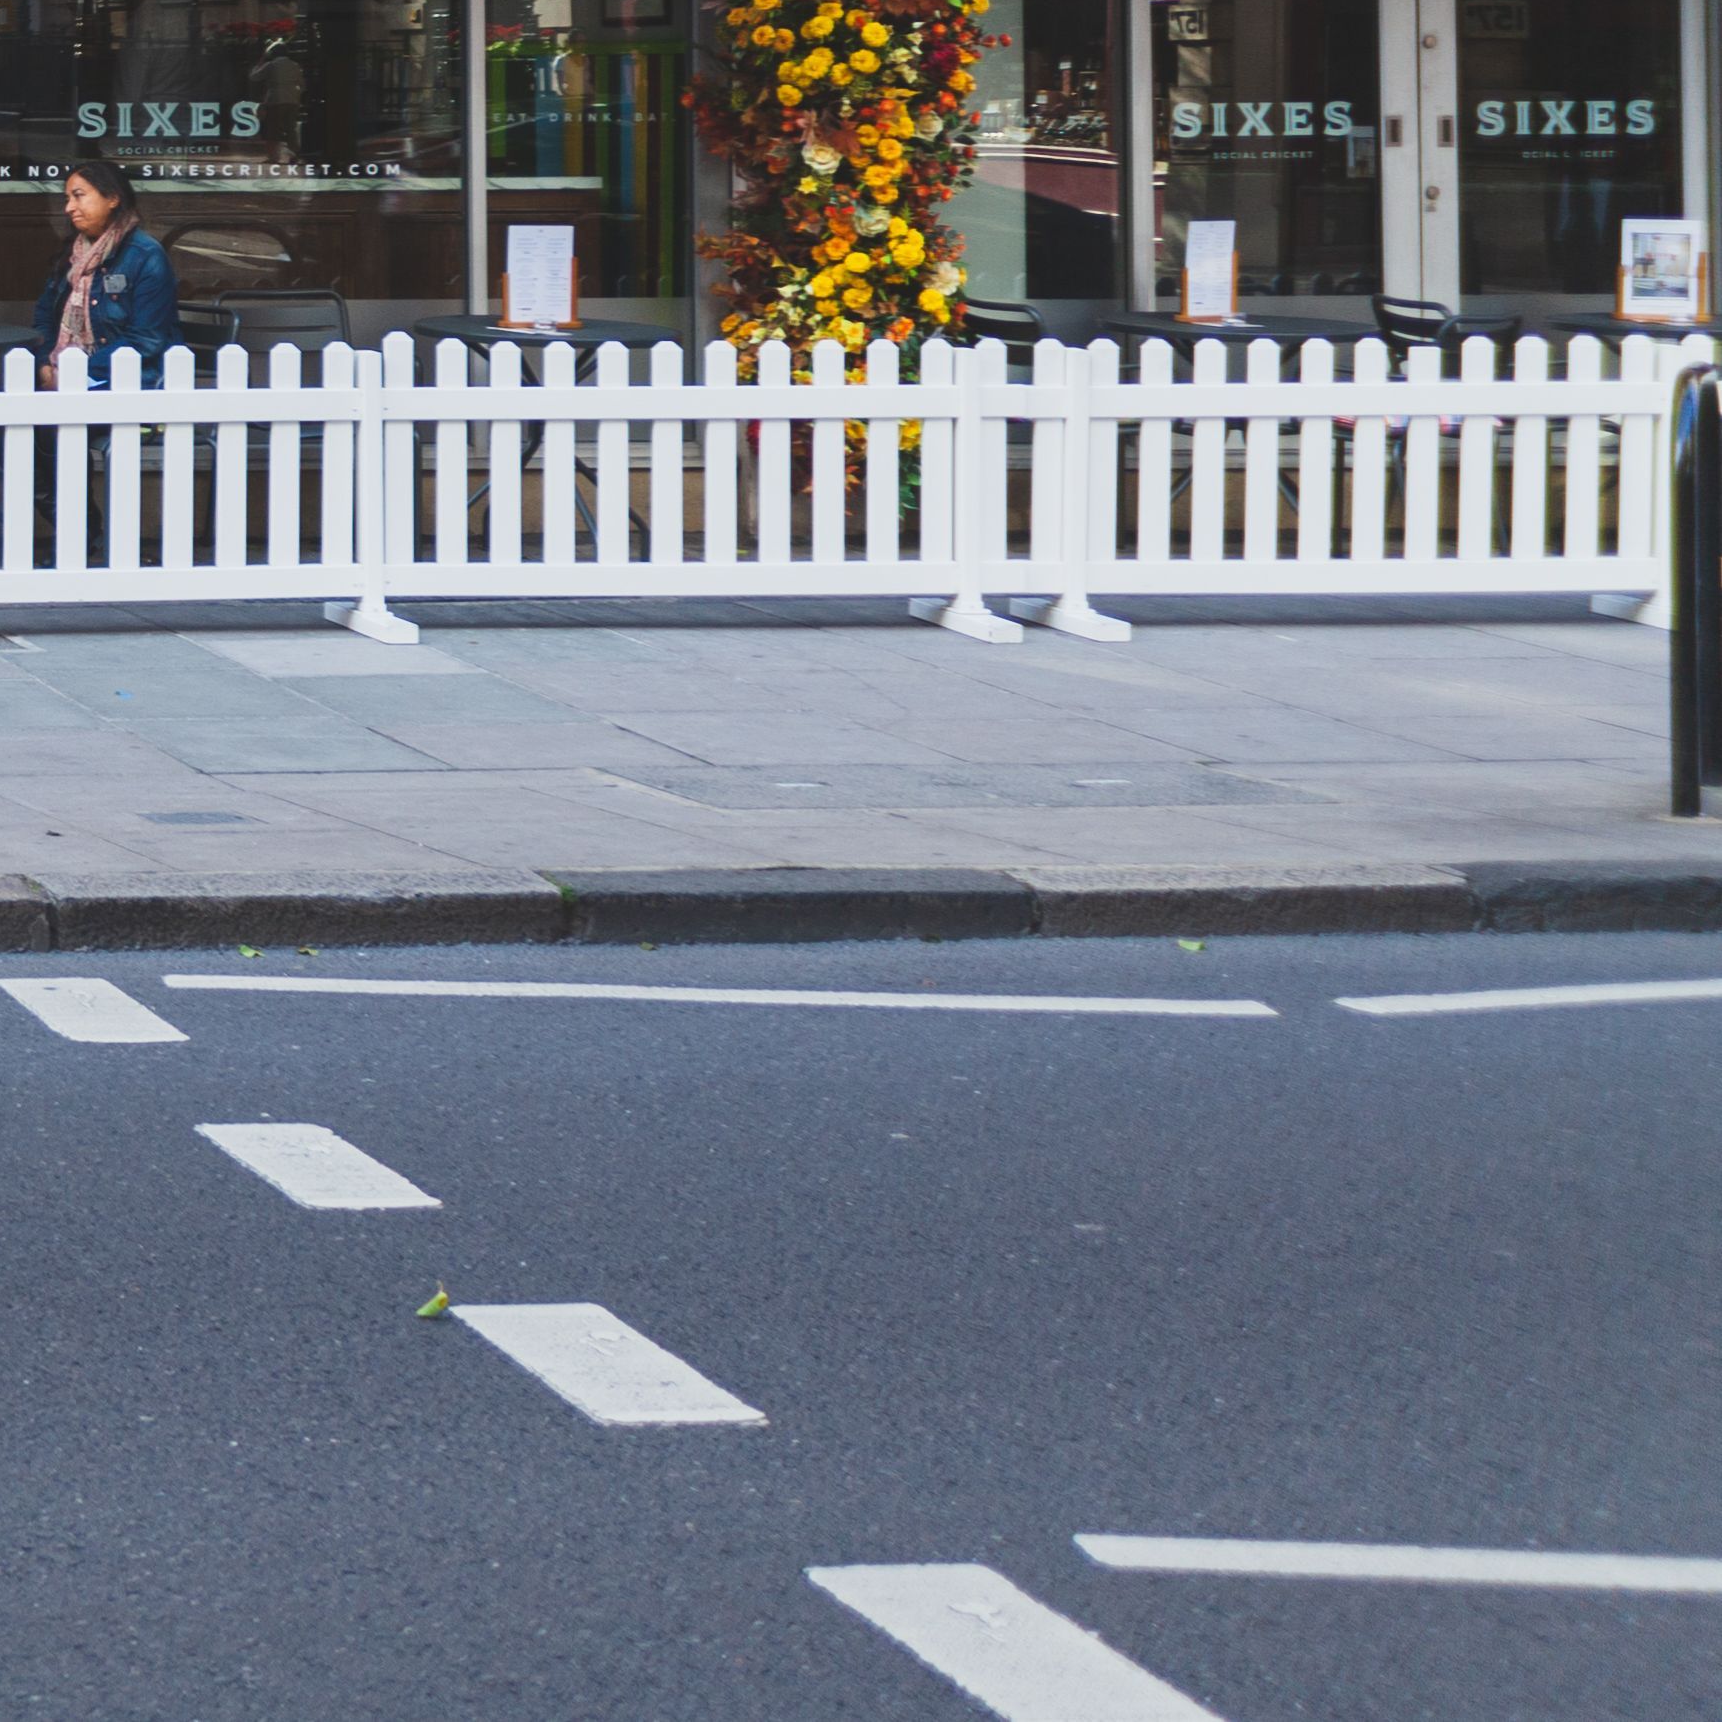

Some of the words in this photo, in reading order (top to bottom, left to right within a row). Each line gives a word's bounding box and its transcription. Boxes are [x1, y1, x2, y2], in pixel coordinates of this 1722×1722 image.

[77, 101, 261, 138] SIXES
[1171, 101, 1354, 138] SIXES
[1475, 99, 1656, 136] SIXES
[117, 146, 163, 156] SOCIAL
[167, 145, 220, 155] CRICKET
[1212, 151, 1258, 160] SOCIAL
[1261, 150, 1314, 159] CRICKET
[28, 165, 71, 177] NO
[142, 163, 403, 177] SIXESCRICKET.COM
